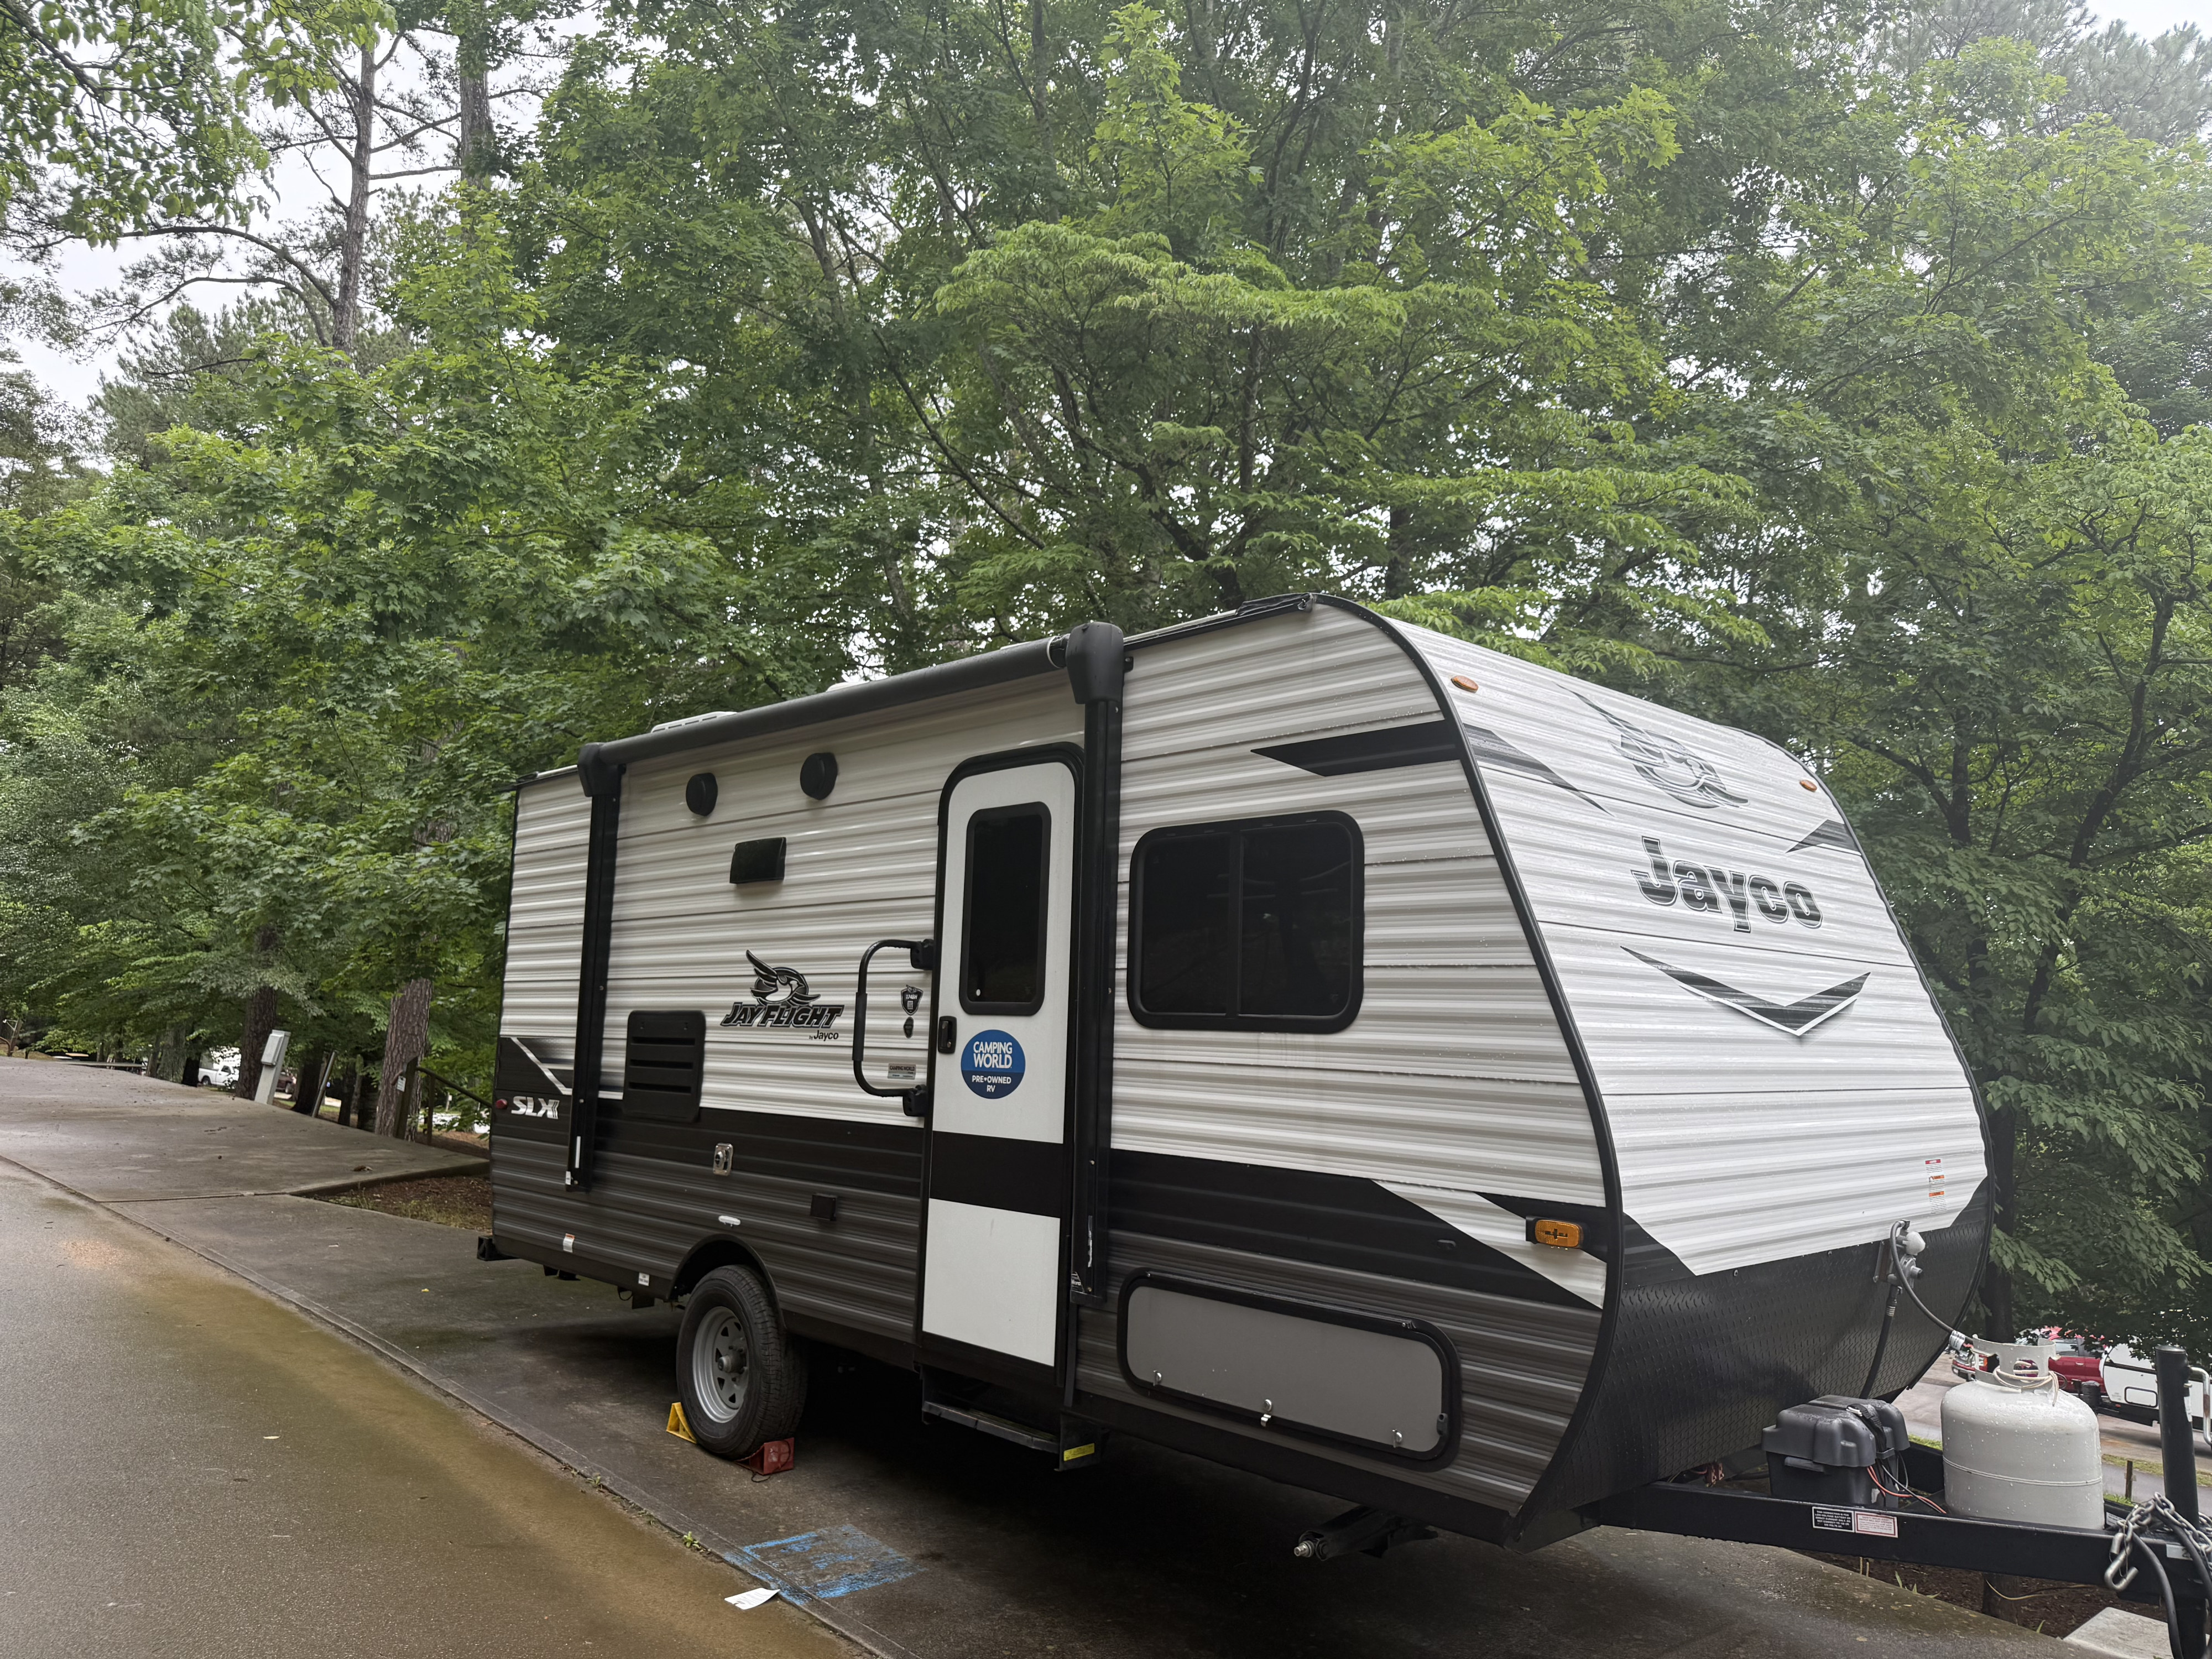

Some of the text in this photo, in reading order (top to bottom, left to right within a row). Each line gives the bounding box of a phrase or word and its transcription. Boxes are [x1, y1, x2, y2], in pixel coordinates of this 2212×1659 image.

[1631, 836, 1823, 933] Jayco
[720, 1002, 845, 1029] JAY FLIGHT
[813, 1030, 839, 1041] Jayco
[973, 1041, 1013, 1054] CAMPING
[973, 1053, 1012, 1069] WORLD
[511, 1095, 560, 1120] SLX
